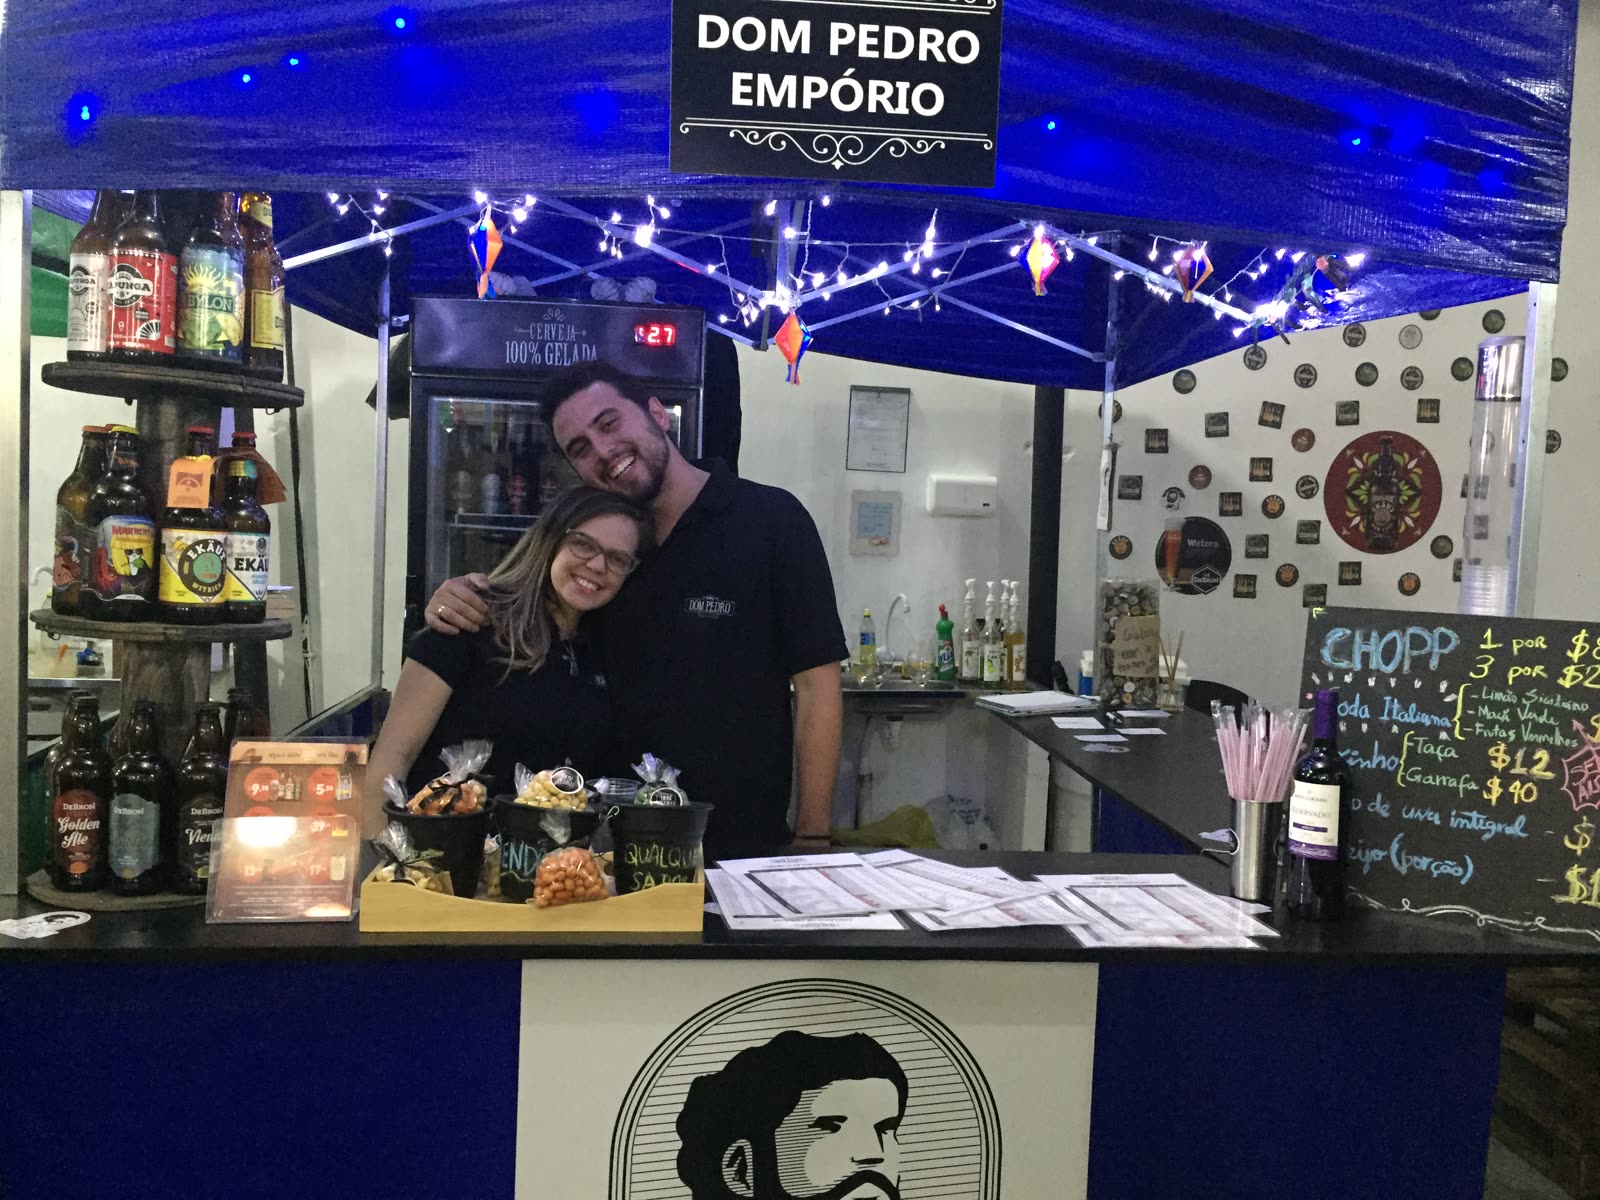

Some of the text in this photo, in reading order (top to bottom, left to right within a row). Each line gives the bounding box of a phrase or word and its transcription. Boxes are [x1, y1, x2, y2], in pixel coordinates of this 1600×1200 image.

[698, 14, 980, 65] DOM PEDRO
[731, 68, 945, 117] EMPÓRIO
[529, 323, 576, 342] CERVEJA
[505, 341, 541, 364] 100%
[1187, 539, 1219, 548] Weizen
[689, 599, 731, 614] DOM PEDRO
[1320, 626, 1460, 674] CHOPP
[1480, 628, 1503, 649] 1
[1469, 655, 1495, 679] 3
[1482, 685, 1517, 704] Limão
[1337, 693, 1452, 728] oda Italiana
[1517, 702, 1560, 726] Verde
[1475, 722, 1516, 742] Frutas
[1412, 736, 1556, 780] Taça $12
[1406, 767, 1538, 805] Garrafa $40
[58, 816, 100, 834] Golden
[1367, 792, 1391, 818] de
[1449, 809, 1528, 841] integral
[61, 831, 89, 848] Ale
